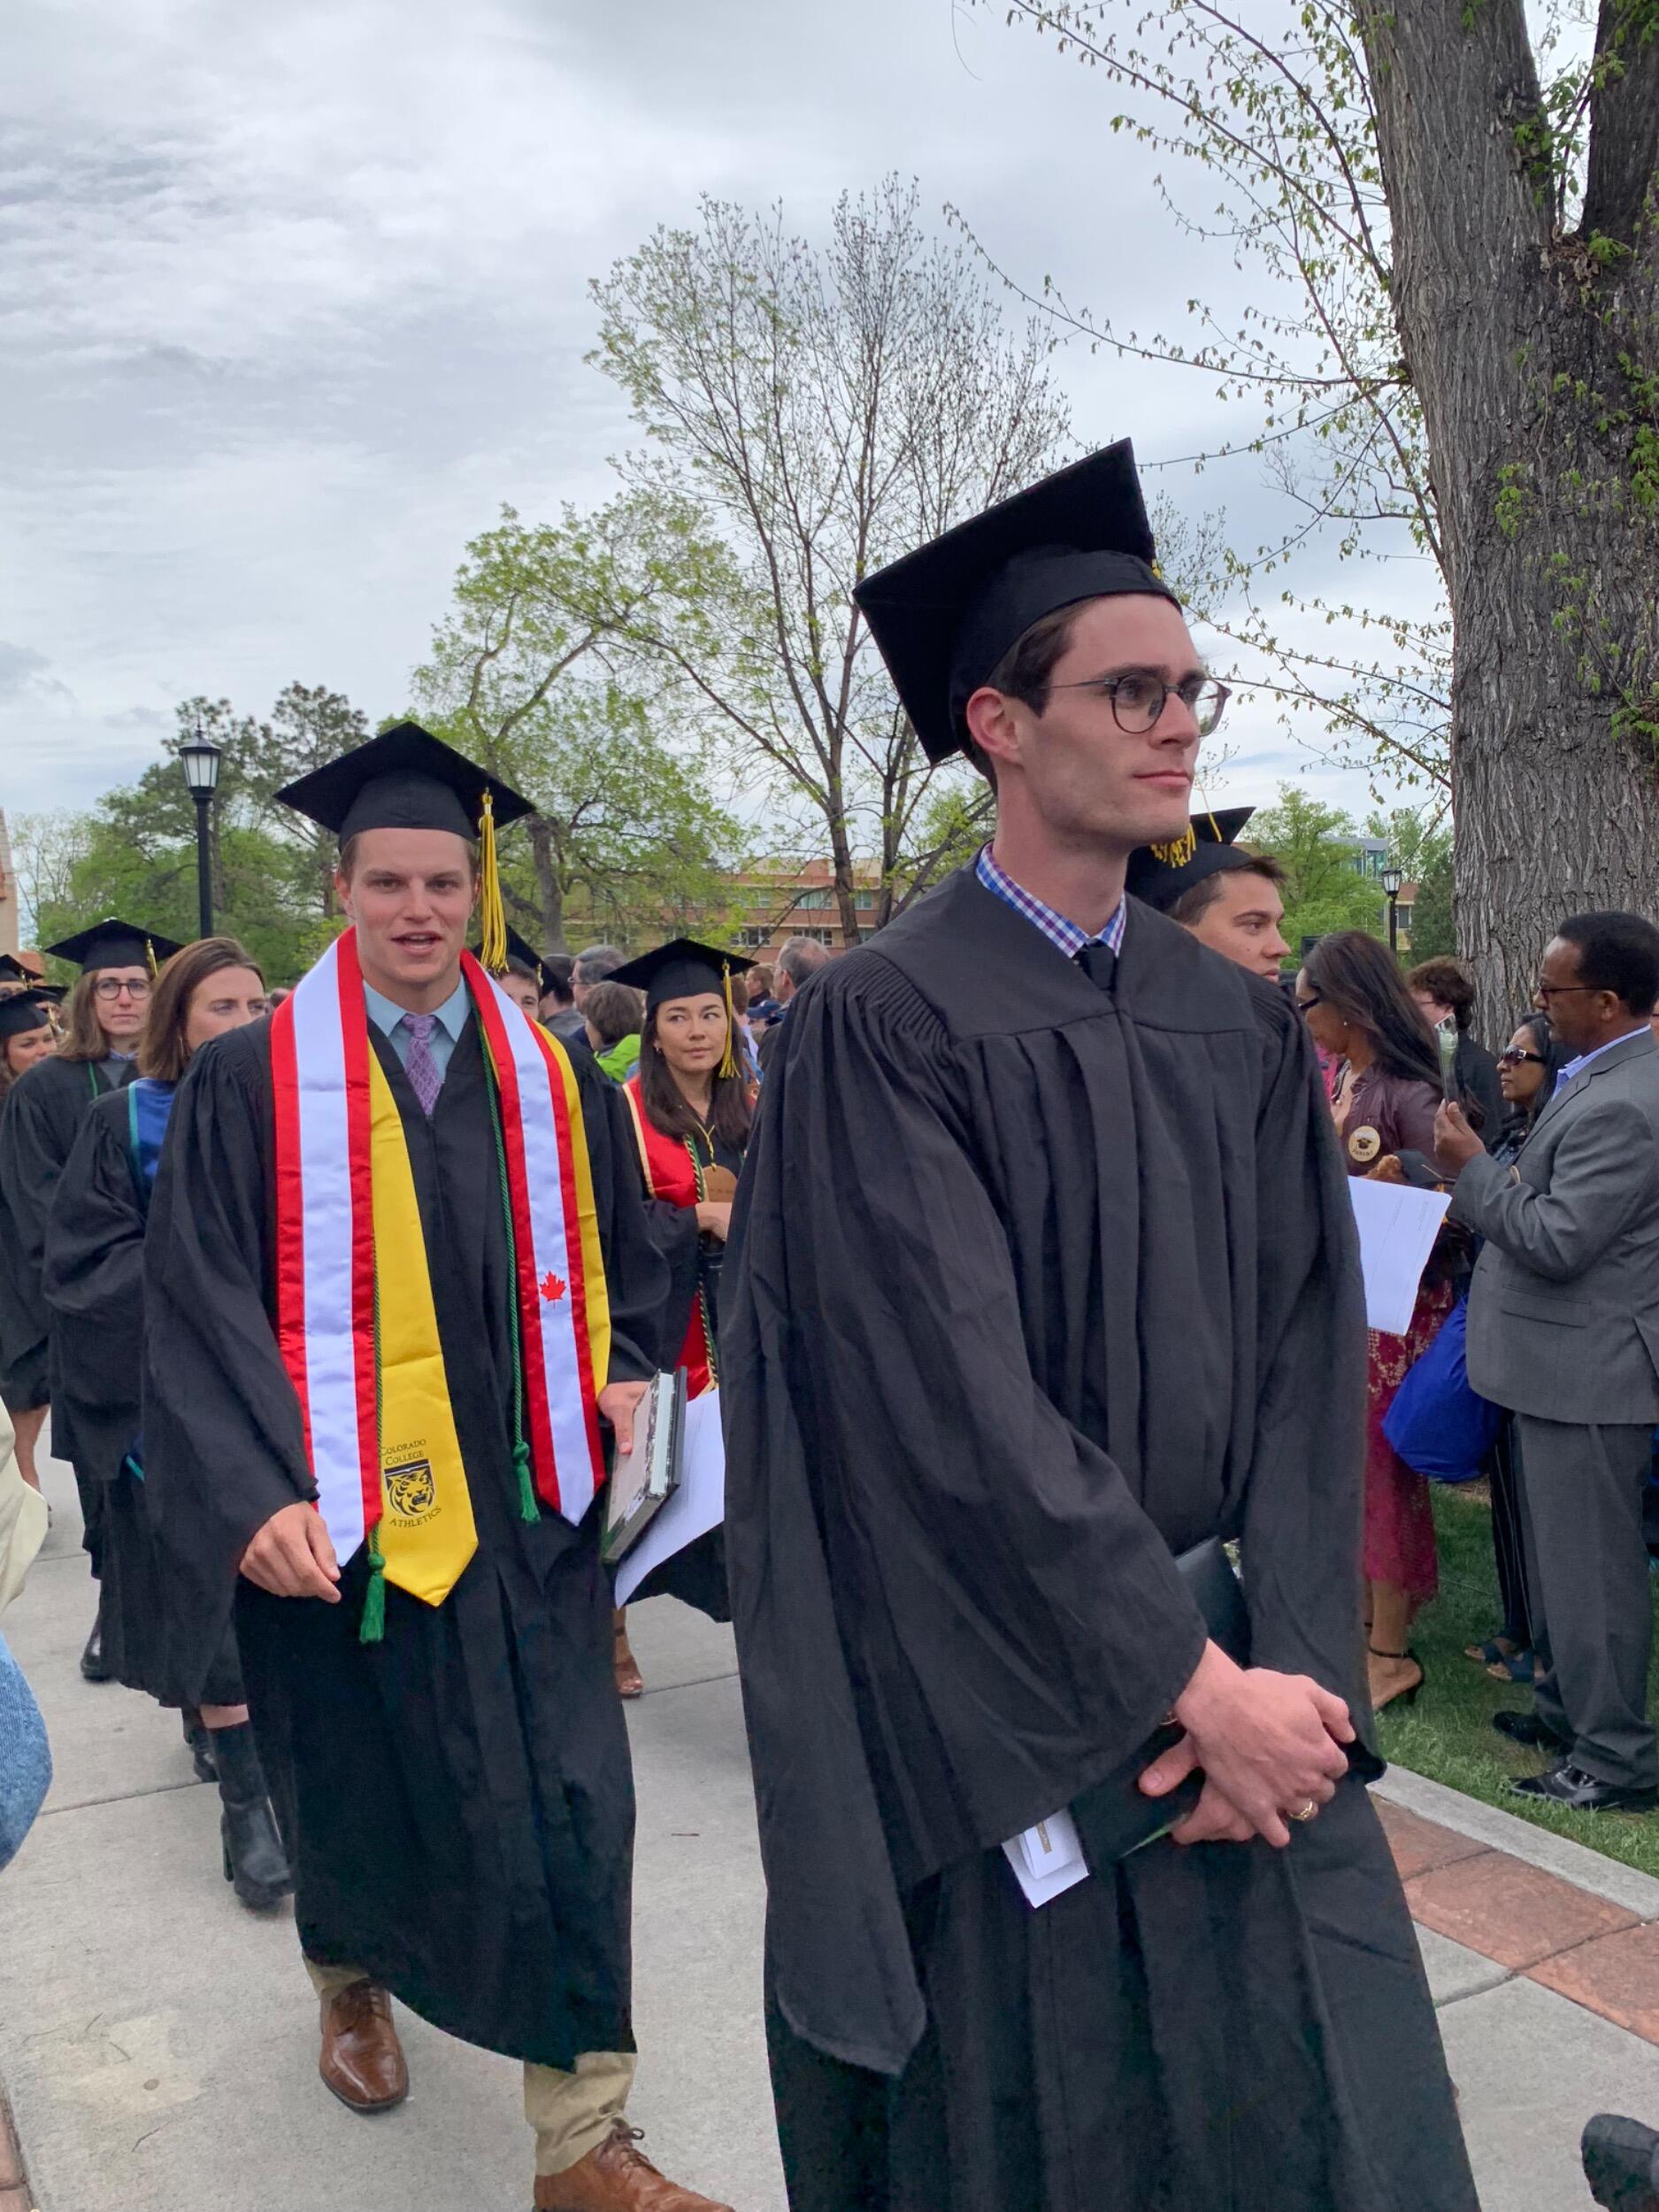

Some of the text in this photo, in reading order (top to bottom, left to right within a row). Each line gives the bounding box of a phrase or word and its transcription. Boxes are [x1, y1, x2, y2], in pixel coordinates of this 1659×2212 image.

[381, 1439, 426, 1455] COLORADO
[385, 1450, 425, 1465] COLLEGE
[389, 1506, 442, 1527] ATHLETICS
